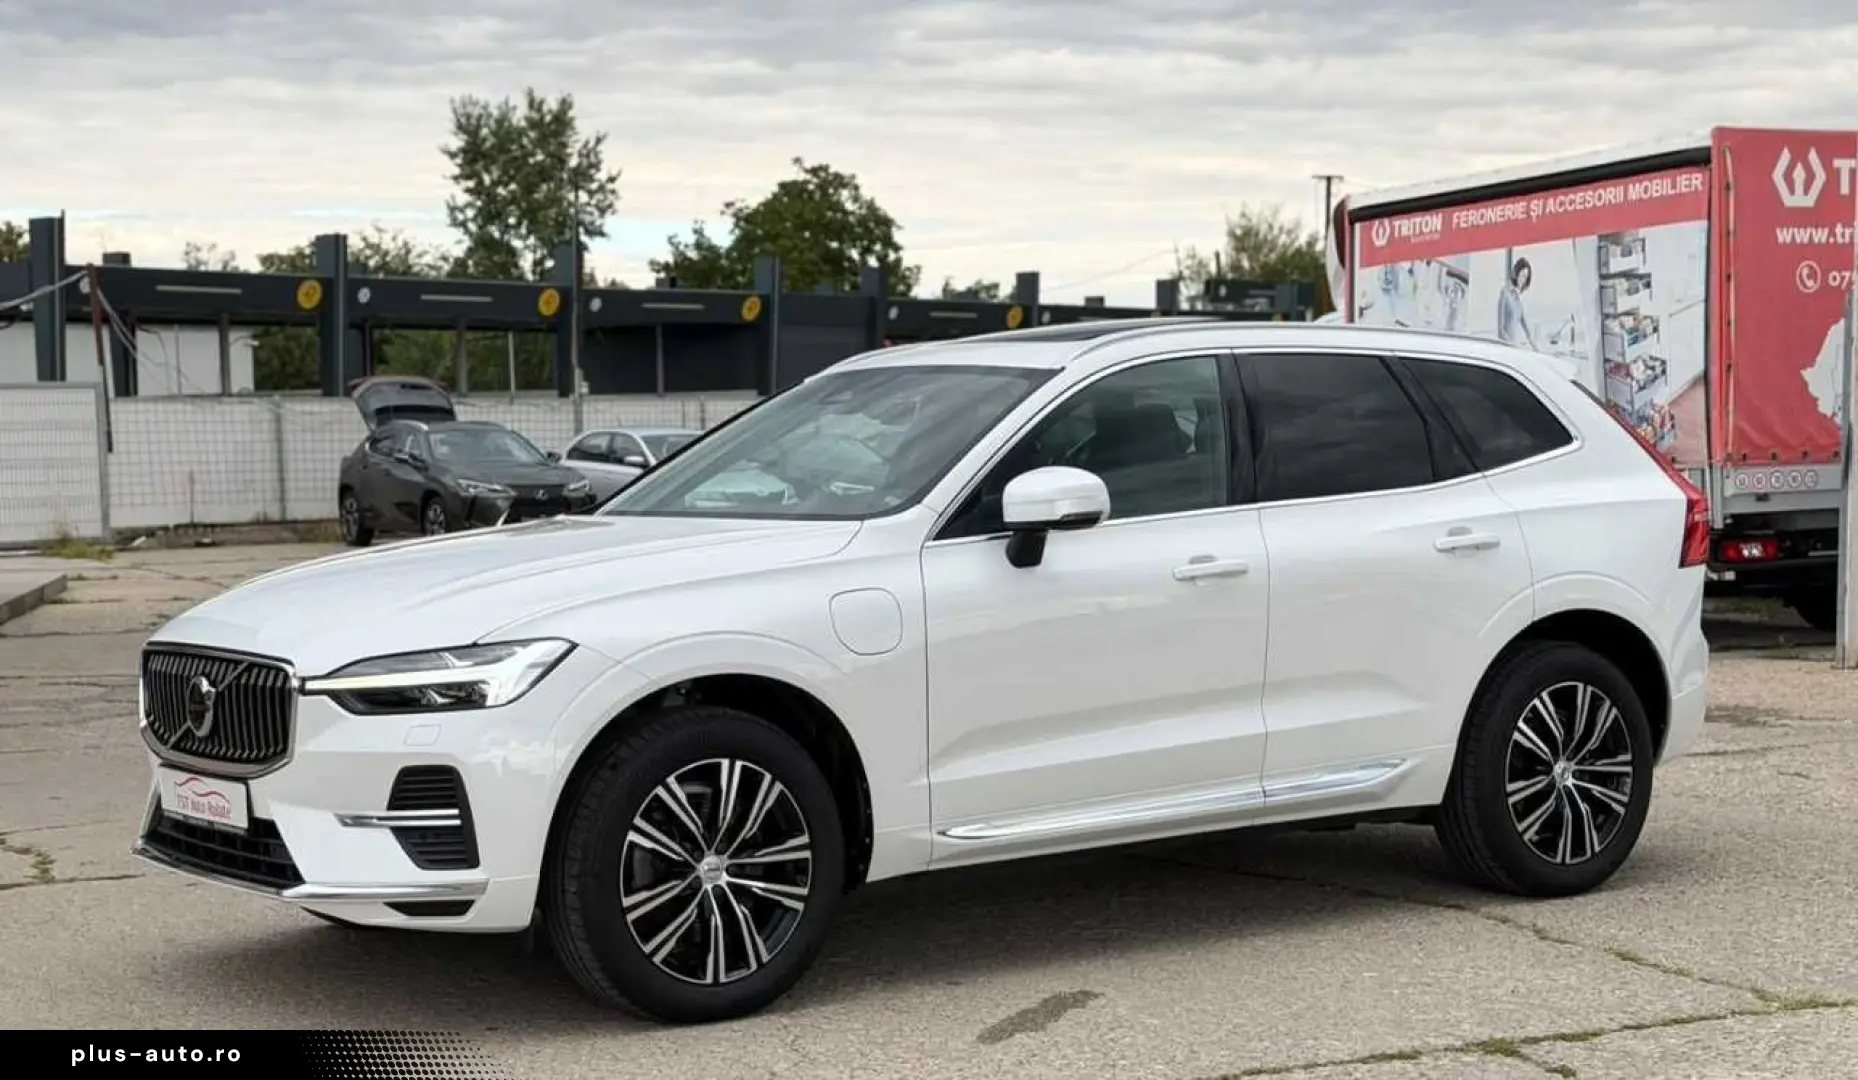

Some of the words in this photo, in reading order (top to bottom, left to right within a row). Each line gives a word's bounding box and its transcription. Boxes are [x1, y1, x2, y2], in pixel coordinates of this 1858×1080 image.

[1393, 212, 1443, 238] TRITON
[1452, 201, 1527, 228] FERONERIE
[1545, 184, 1624, 216] ACCESORII
[1627, 173, 1704, 201] MOBILIER
